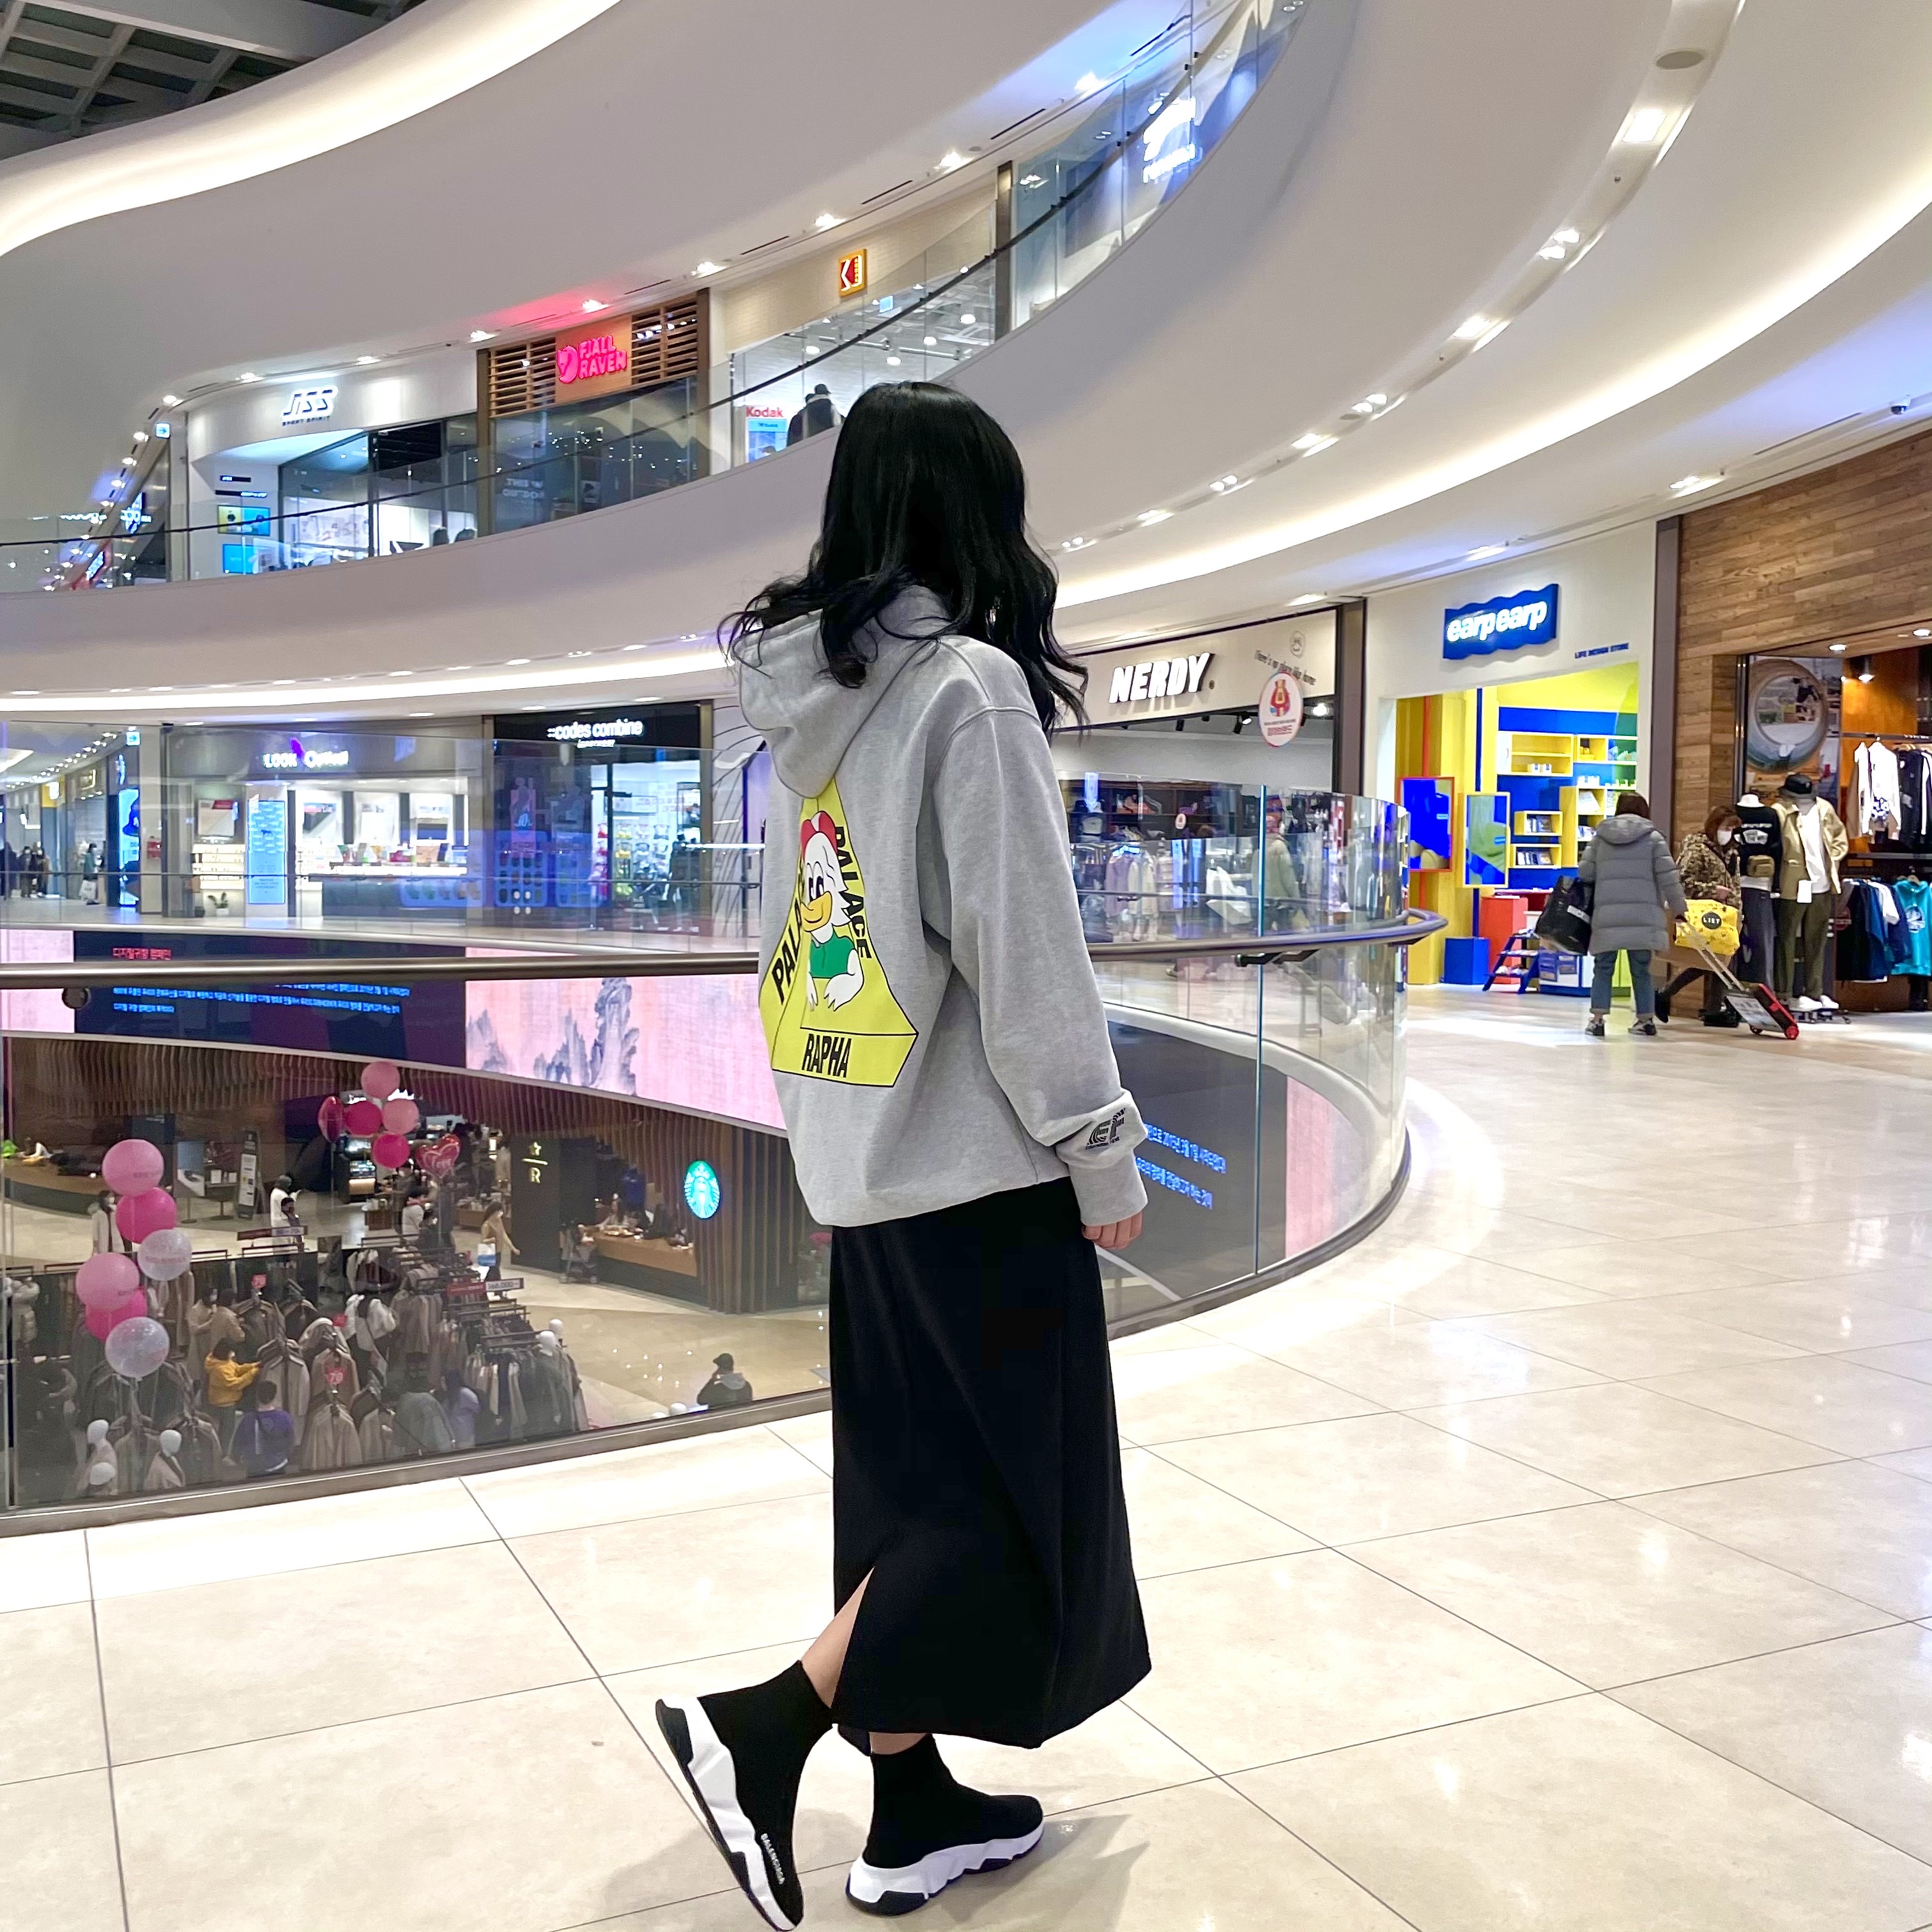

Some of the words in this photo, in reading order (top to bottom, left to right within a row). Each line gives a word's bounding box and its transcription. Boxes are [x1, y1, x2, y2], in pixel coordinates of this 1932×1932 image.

[746, 406, 784, 418] Kodak
[1446, 612, 1496, 642] earp
[1496, 601, 1548, 632] earp
[592, 718, 643, 738] combine
[263, 753, 298, 768] LOOK
[802, 1033, 852, 1078] RAPHA
[531, 1167, 541, 1184] R
